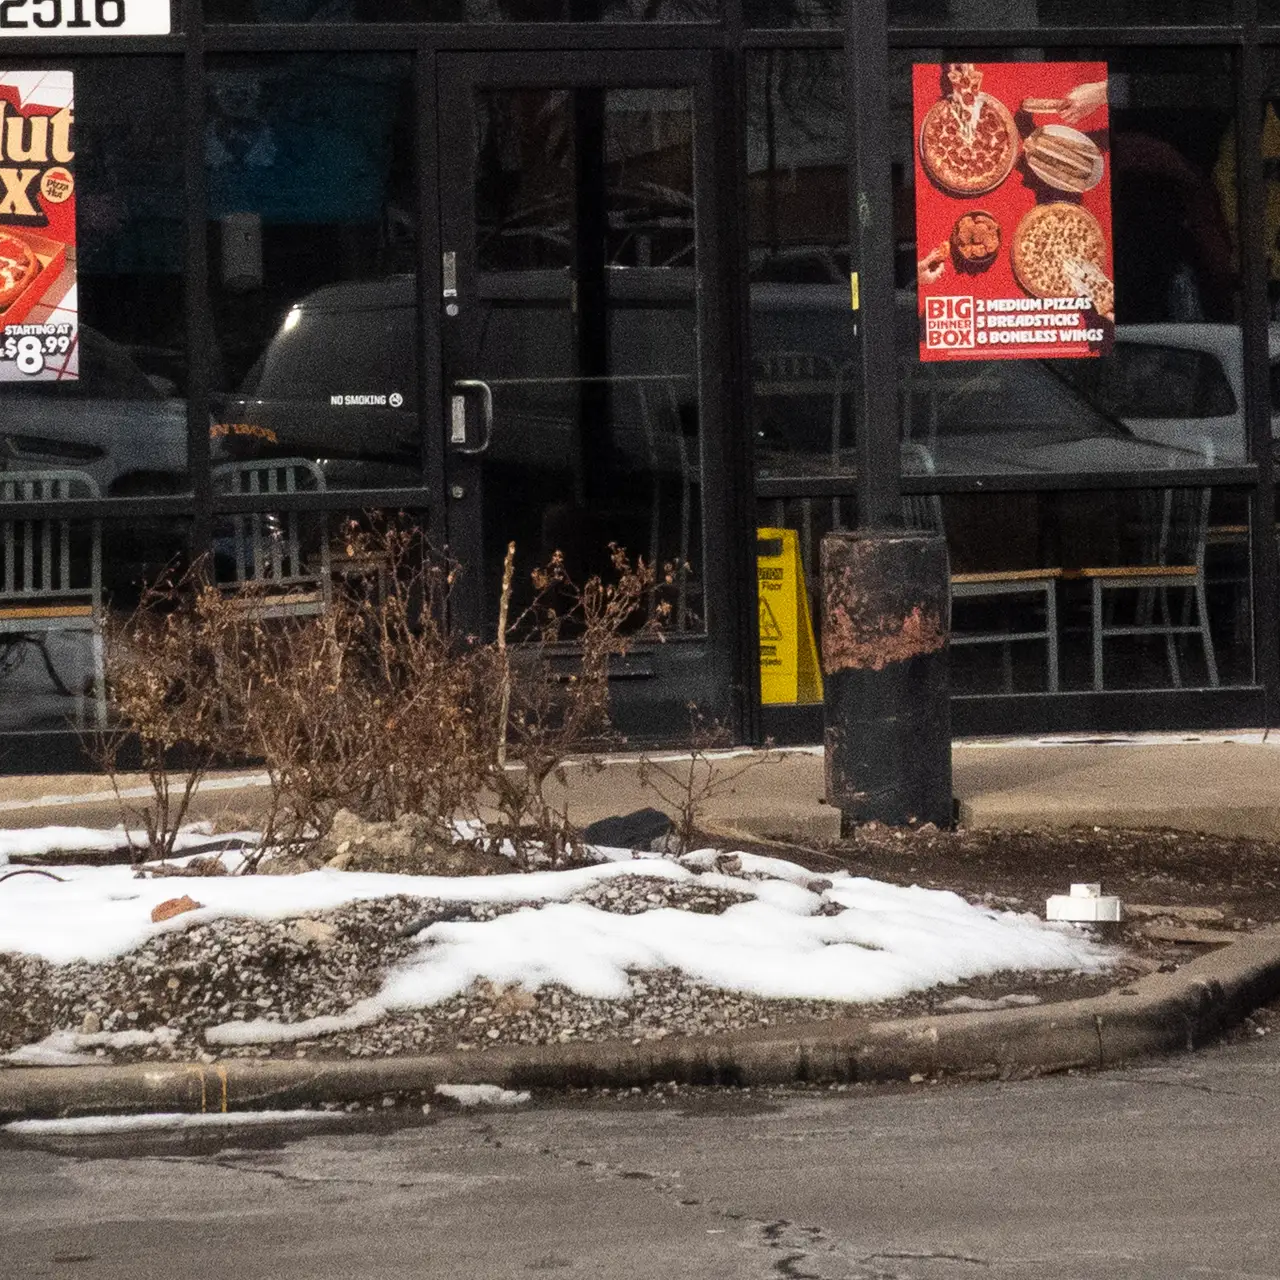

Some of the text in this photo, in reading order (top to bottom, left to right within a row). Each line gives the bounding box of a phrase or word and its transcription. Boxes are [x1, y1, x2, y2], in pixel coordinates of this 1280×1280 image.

[927, 299, 972, 318] BIG
[976, 297, 1092, 311] 2 MEDIUM PIZZAS
[928, 320, 972, 329] DINNER
[976, 314, 1080, 328] 5 BREADSTICKS
[5, 324, 70, 335] STARTING AT
[976, 329, 1104, 344] 8 BONELESS WINGS
[928, 330, 972, 346] BOX
[5, 336, 70, 374] $8.99
[330, 395, 387, 405] NO SMOKING
